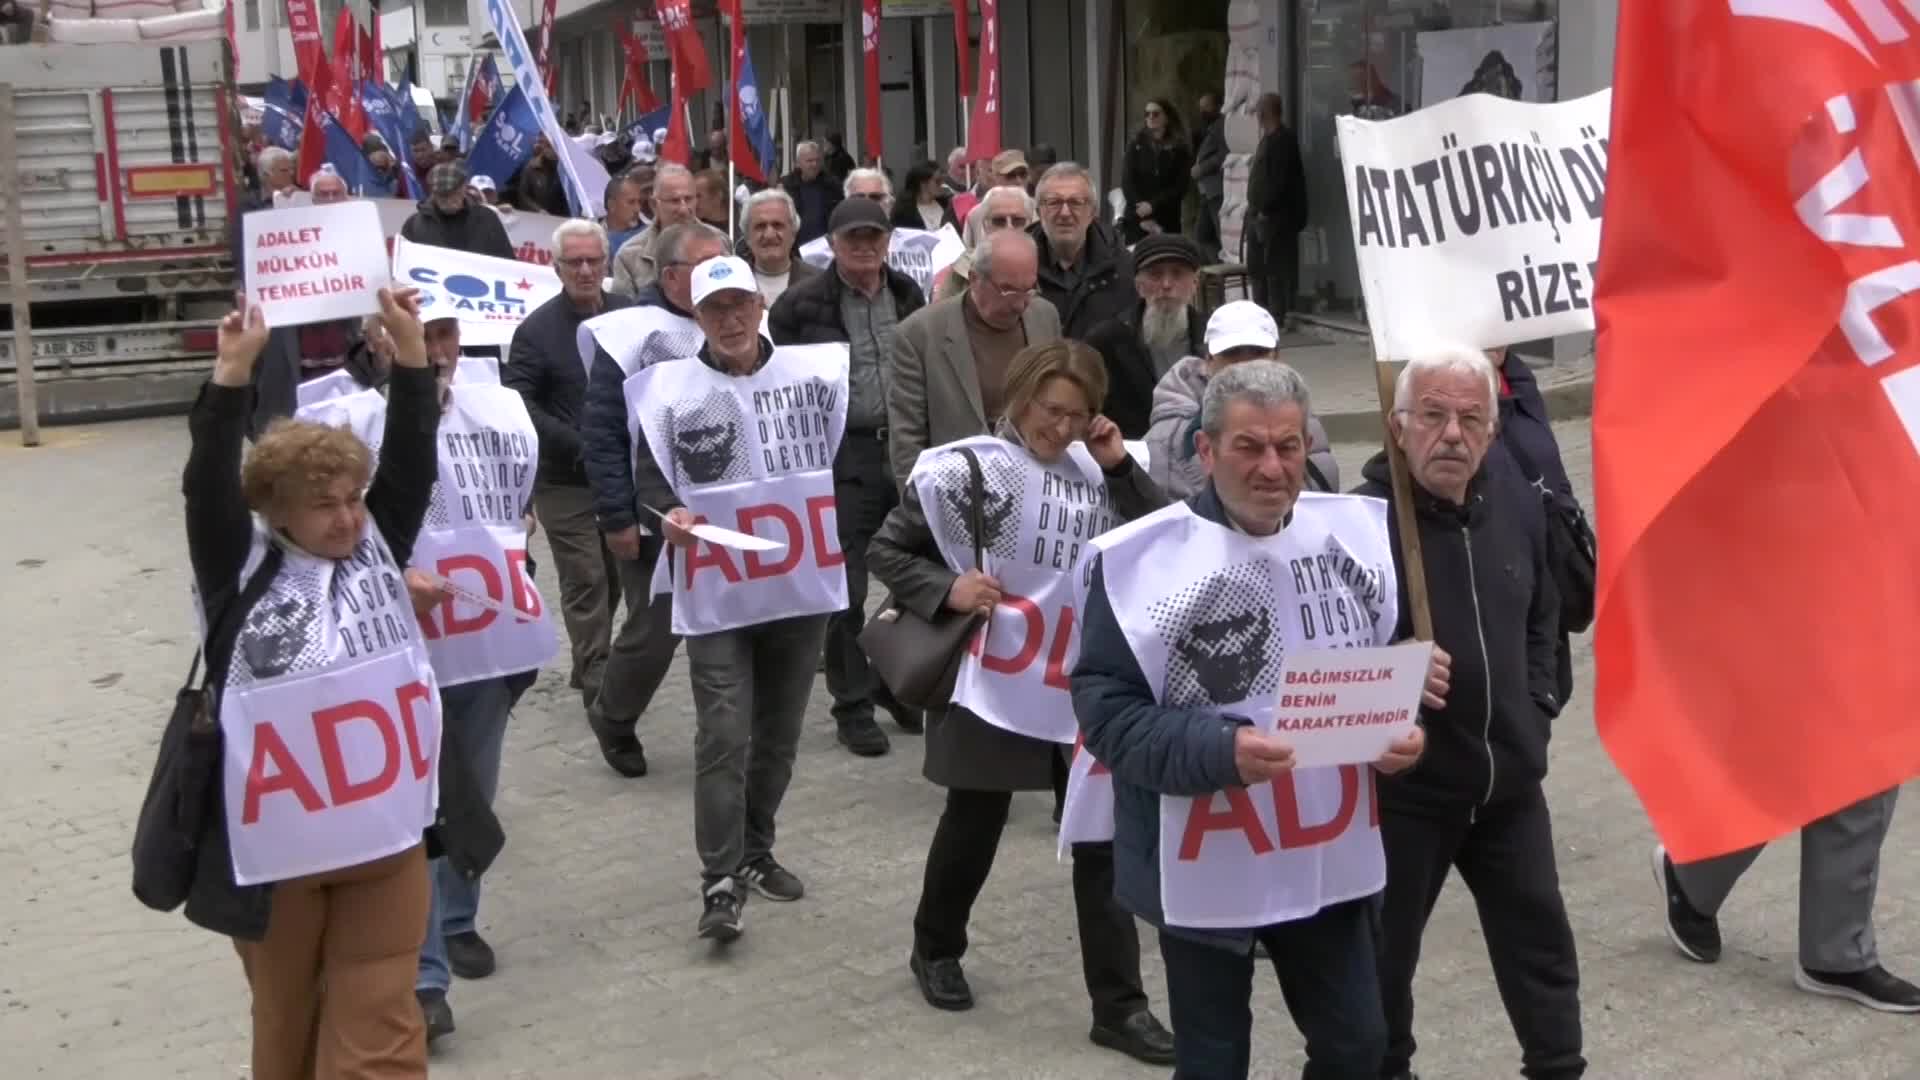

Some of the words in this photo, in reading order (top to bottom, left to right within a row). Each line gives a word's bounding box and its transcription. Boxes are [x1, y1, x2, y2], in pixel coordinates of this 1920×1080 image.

[1355, 131, 1572, 249] ATATÜRKÇÜ
[257, 227, 323, 248] ADALET
[257, 251, 338, 275] MÜLKÜN
[257, 274, 366, 302] TEMELİDİR
[1496, 254, 1589, 322] RİZE
[450, 296, 526, 315] ARTİ
[763, 441, 827, 472] DERNE
[1285, 667, 1395, 685] BAĞIMSIZLIK
[1280, 691, 1337, 708] BENİM
[1276, 708, 1410, 731] KARAKTERİMDİR
[241, 679, 431, 826] ADD
